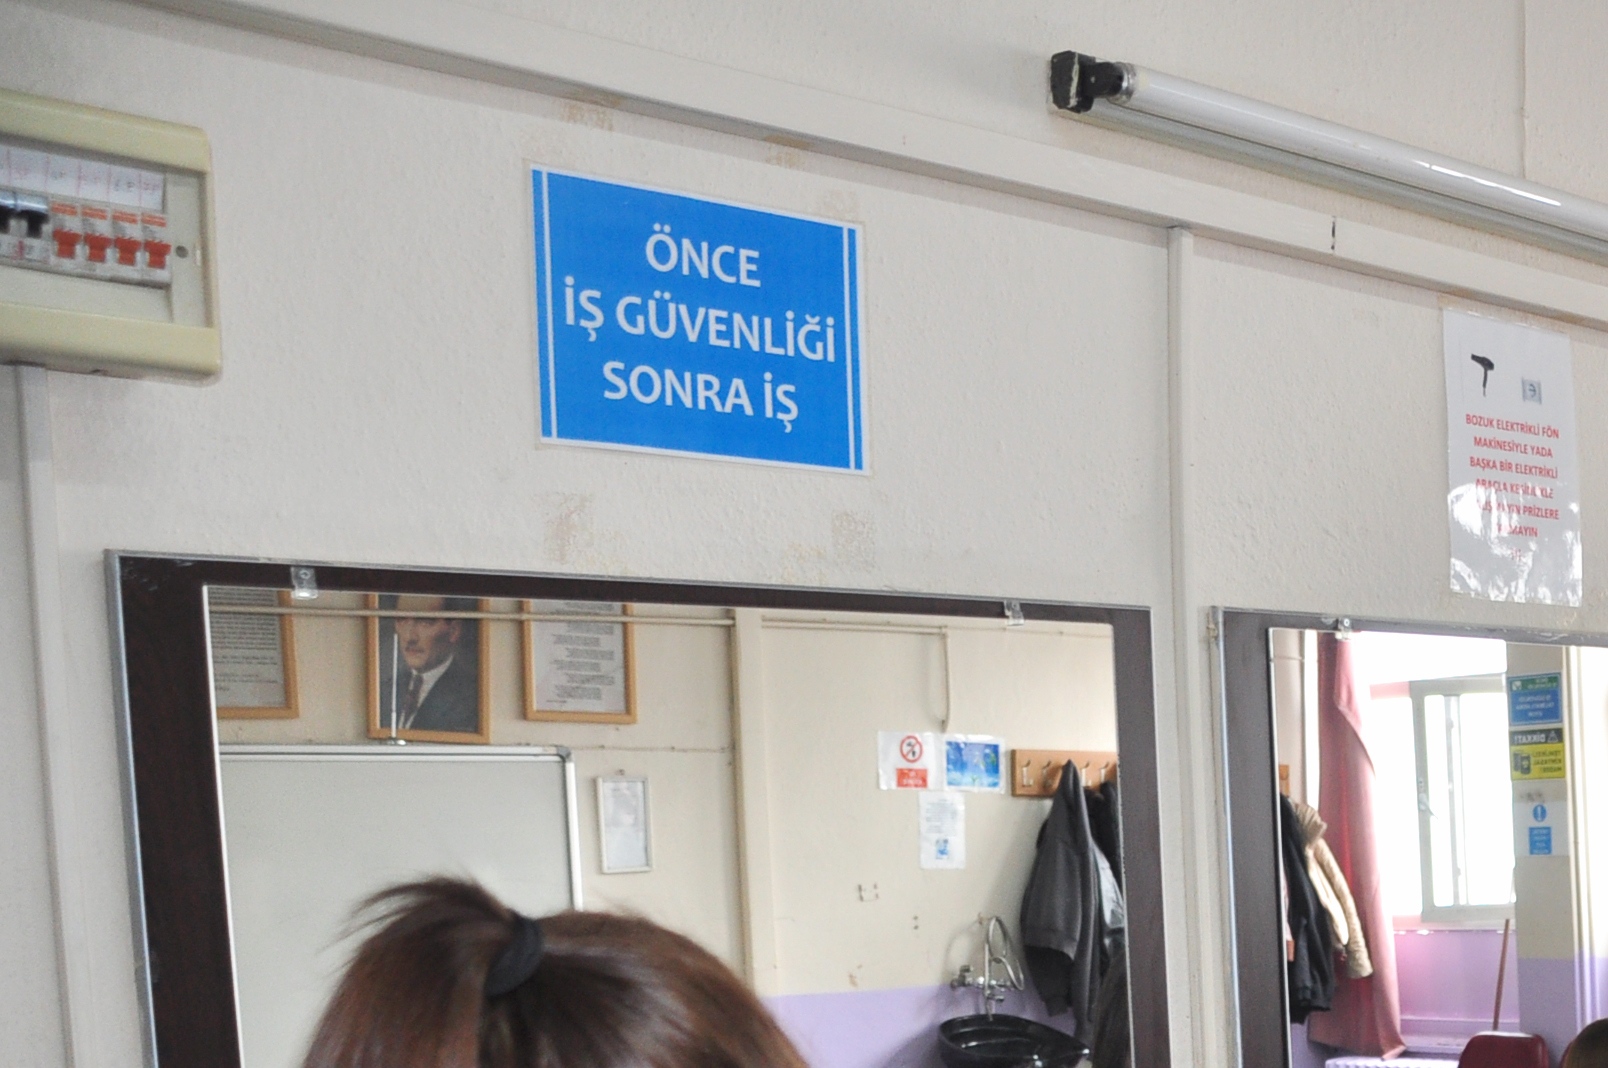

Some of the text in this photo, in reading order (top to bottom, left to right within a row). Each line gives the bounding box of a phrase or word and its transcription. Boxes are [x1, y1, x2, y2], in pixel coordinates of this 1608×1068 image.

[645, 222, 761, 287] ÖNCE
[564, 275, 835, 363] İŞ GÜVENLİĞİ
[602, 360, 799, 433] SONRA İŞ
[1465, 413, 1559, 439] BOZUK ELEKTRİKLİ FÖN
[1473, 436, 1553, 458] MAKİNESİYLE YADA
[1469, 456, 1558, 479] BAŞKA BİR ELEKTRİKLİ
[1522, 504, 1559, 520] PRİZLERE
